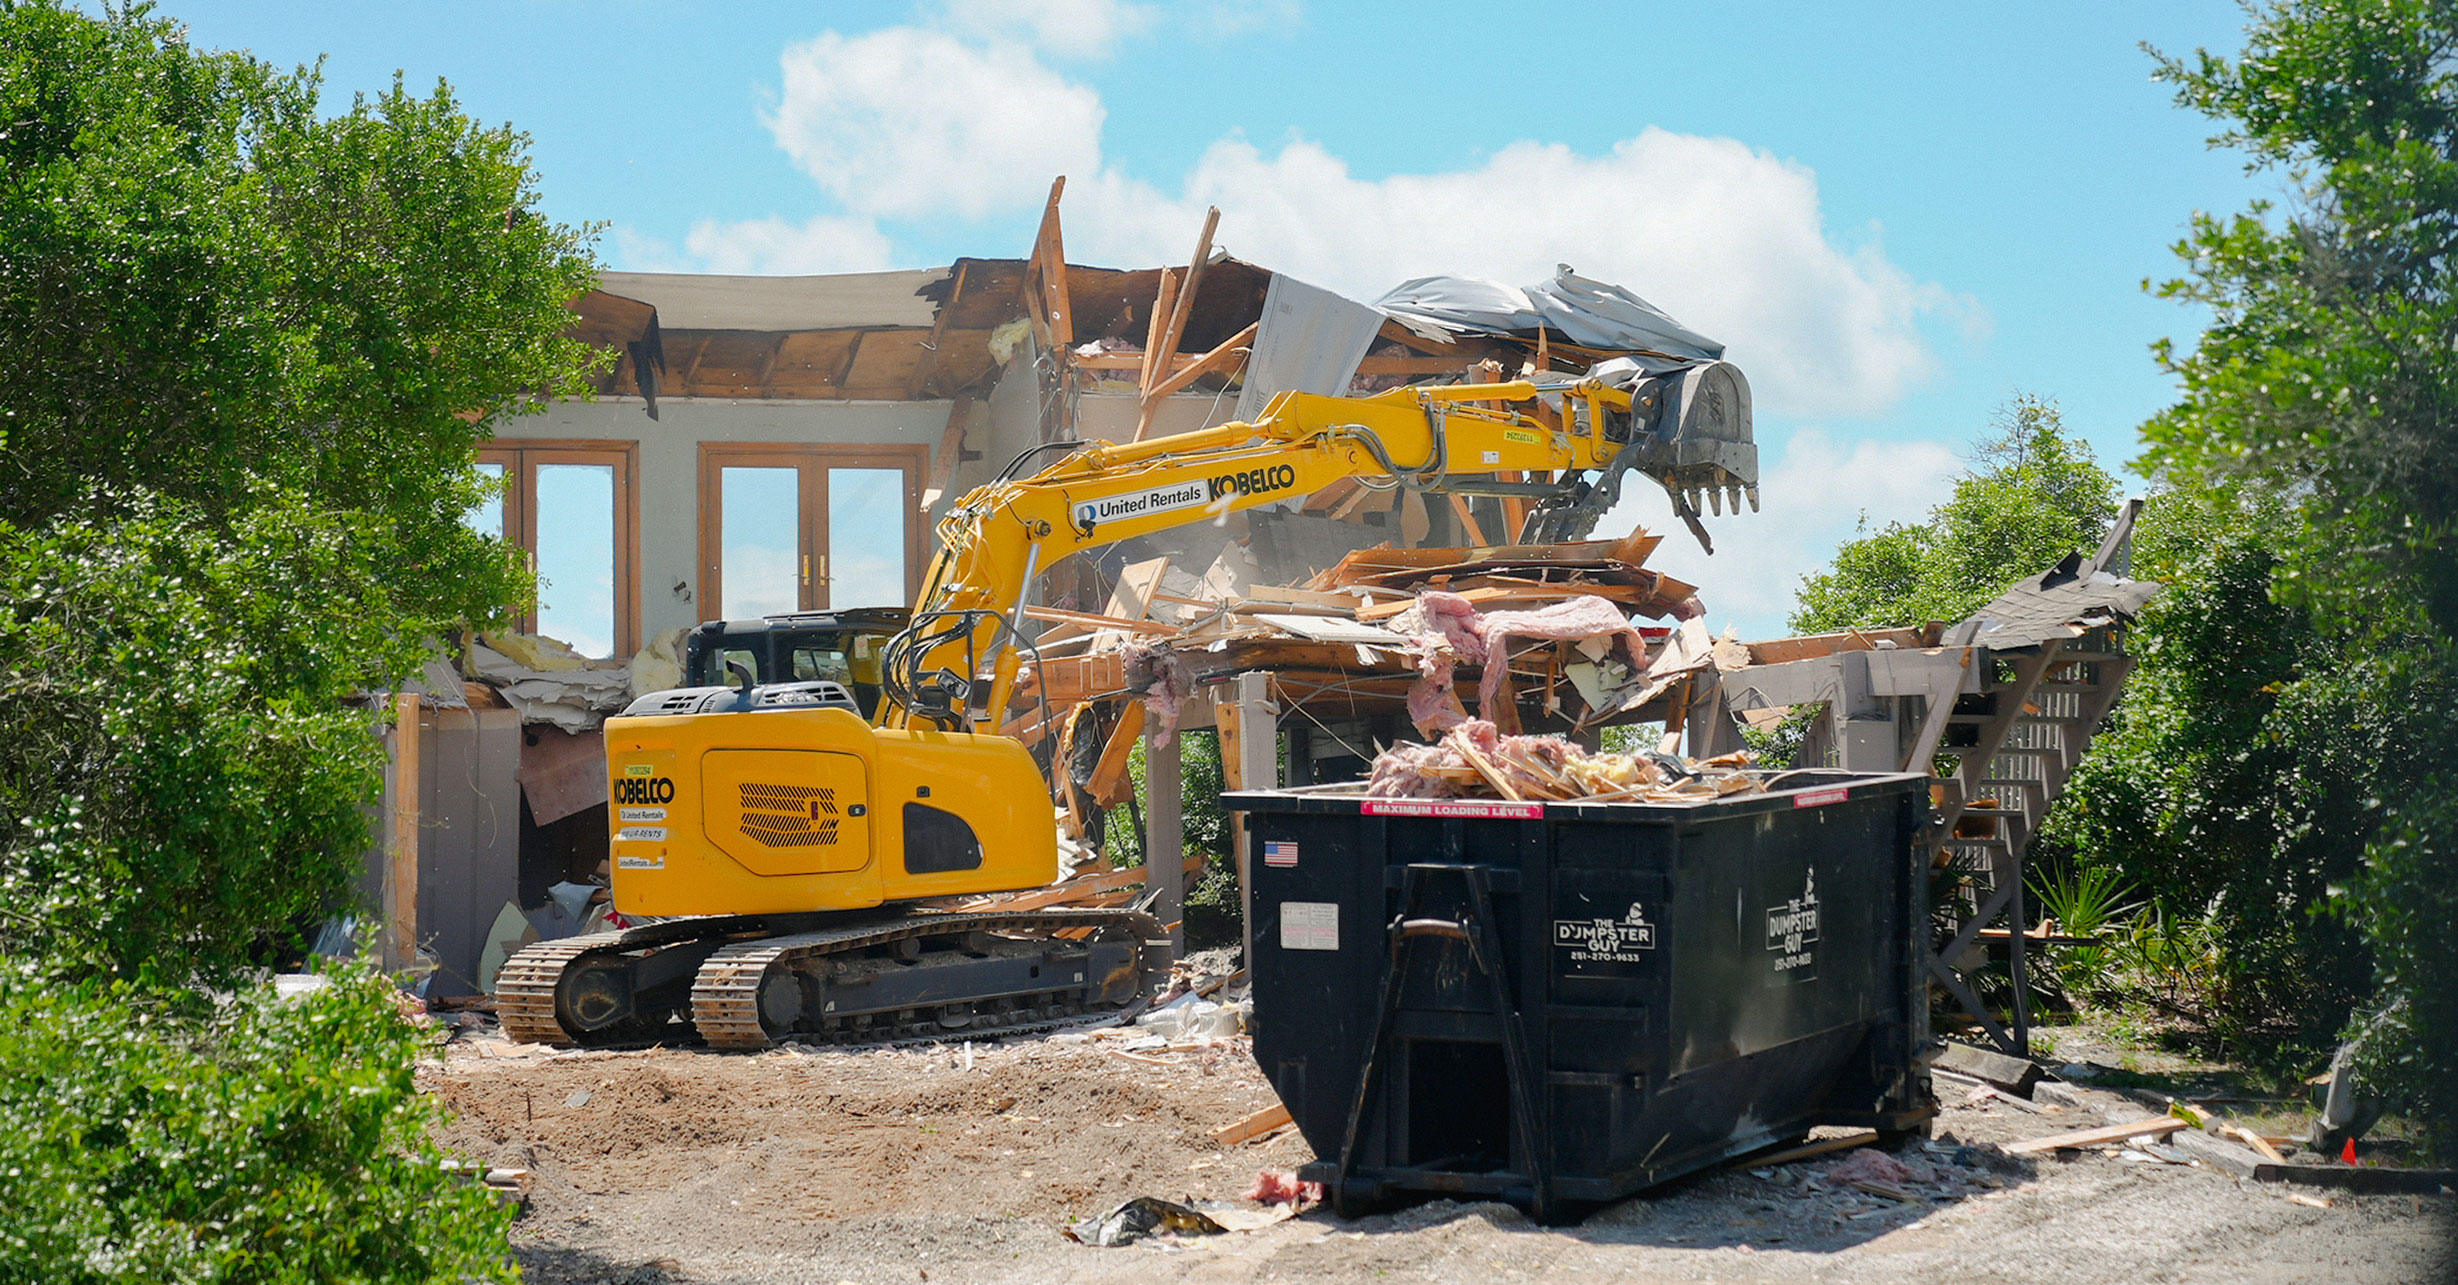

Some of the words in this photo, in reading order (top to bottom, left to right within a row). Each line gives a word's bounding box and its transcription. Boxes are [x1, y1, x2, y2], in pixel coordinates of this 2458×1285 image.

[1208, 464, 1295, 502] KOBELCO
[1100, 495, 1146, 517] United
[1150, 486, 1201, 508] Rentals
[613, 777, 675, 804] KOBELCO
[1372, 804, 1431, 814] MAXIMUM
[1435, 806, 1489, 816] LOADING
[1492, 807, 1531, 817] LEVEL
[1788, 899, 1800, 912] THE
[1593, 918, 1614, 928] THE
[1769, 910, 1816, 938] DUMPSTER
[1588, 939, 1620, 952] GUY
[1785, 932, 1803, 954] GUY
[1570, 951, 1640, 962] 251-270-9633
